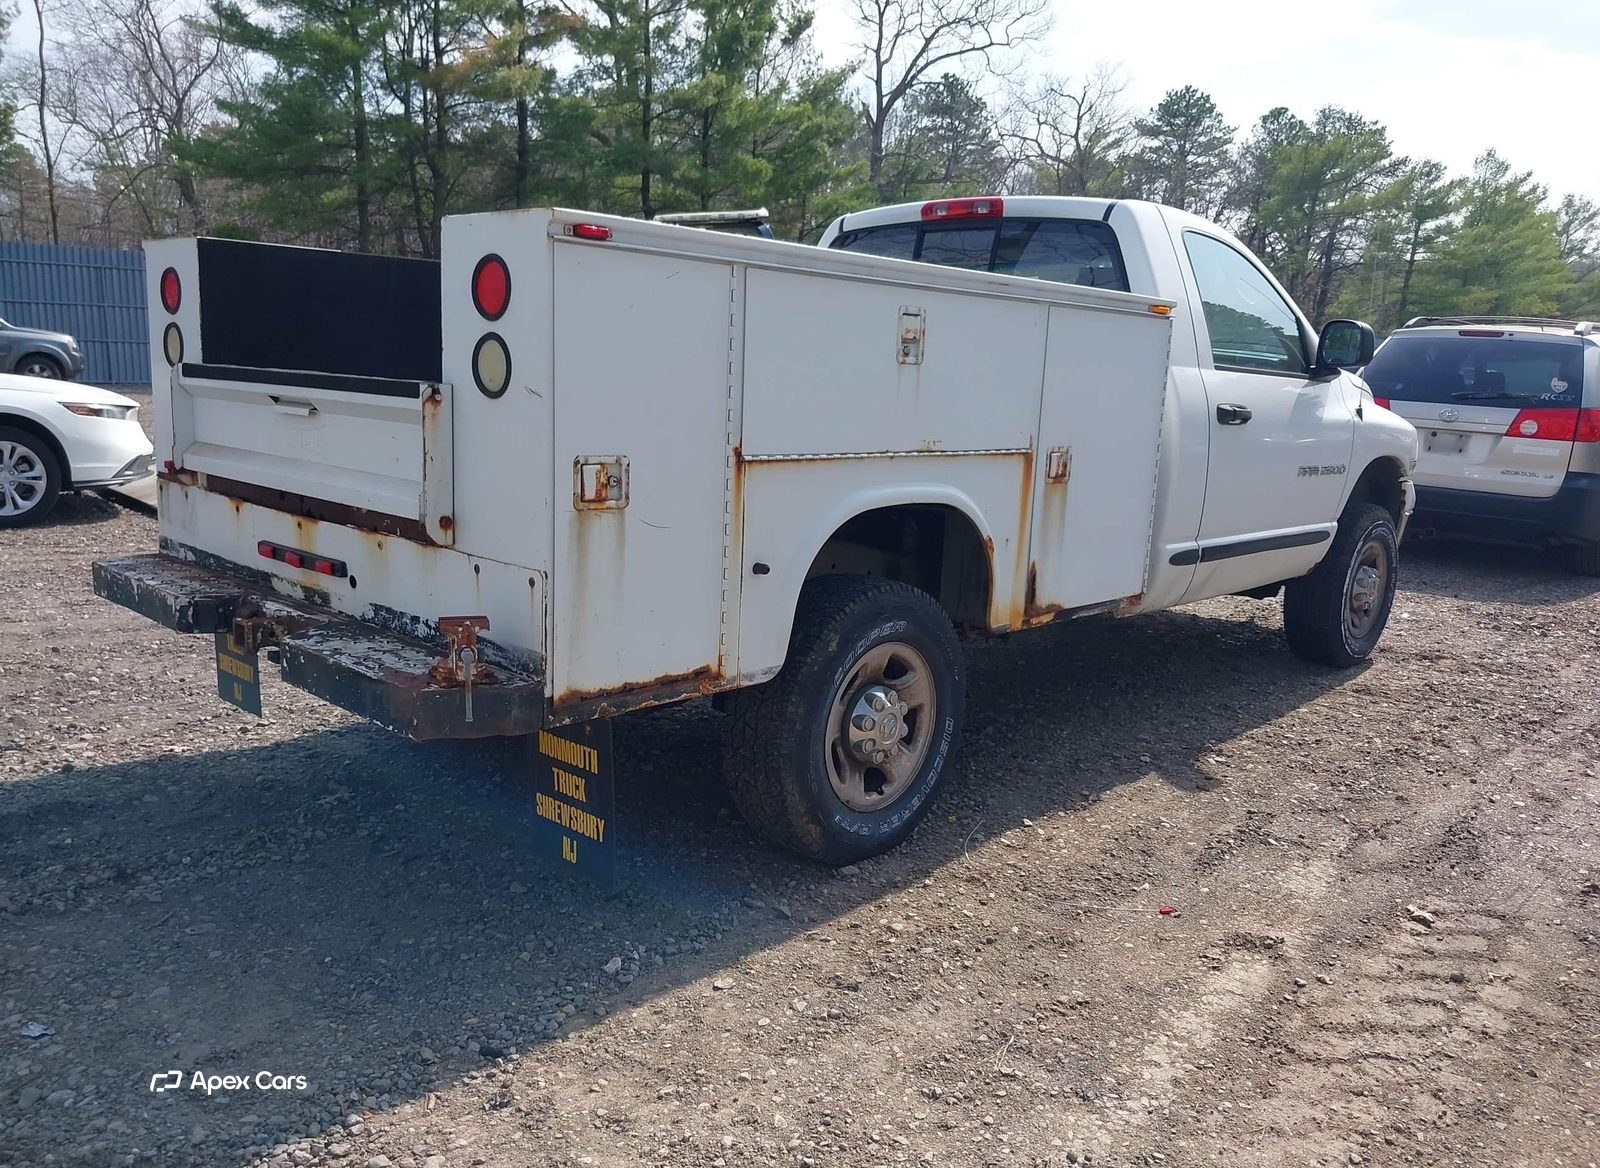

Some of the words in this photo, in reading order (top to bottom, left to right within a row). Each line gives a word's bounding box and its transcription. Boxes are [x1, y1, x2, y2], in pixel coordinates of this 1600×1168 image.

[833, 620, 907, 689] COOPER
[538, 729, 599, 775] MONMOUTH
[878, 716, 955, 834] DISCOVERER
[551, 766, 587, 803] TRUCK
[535, 791, 605, 843] SHREWSBURY
[562, 835, 578, 864] NJ
